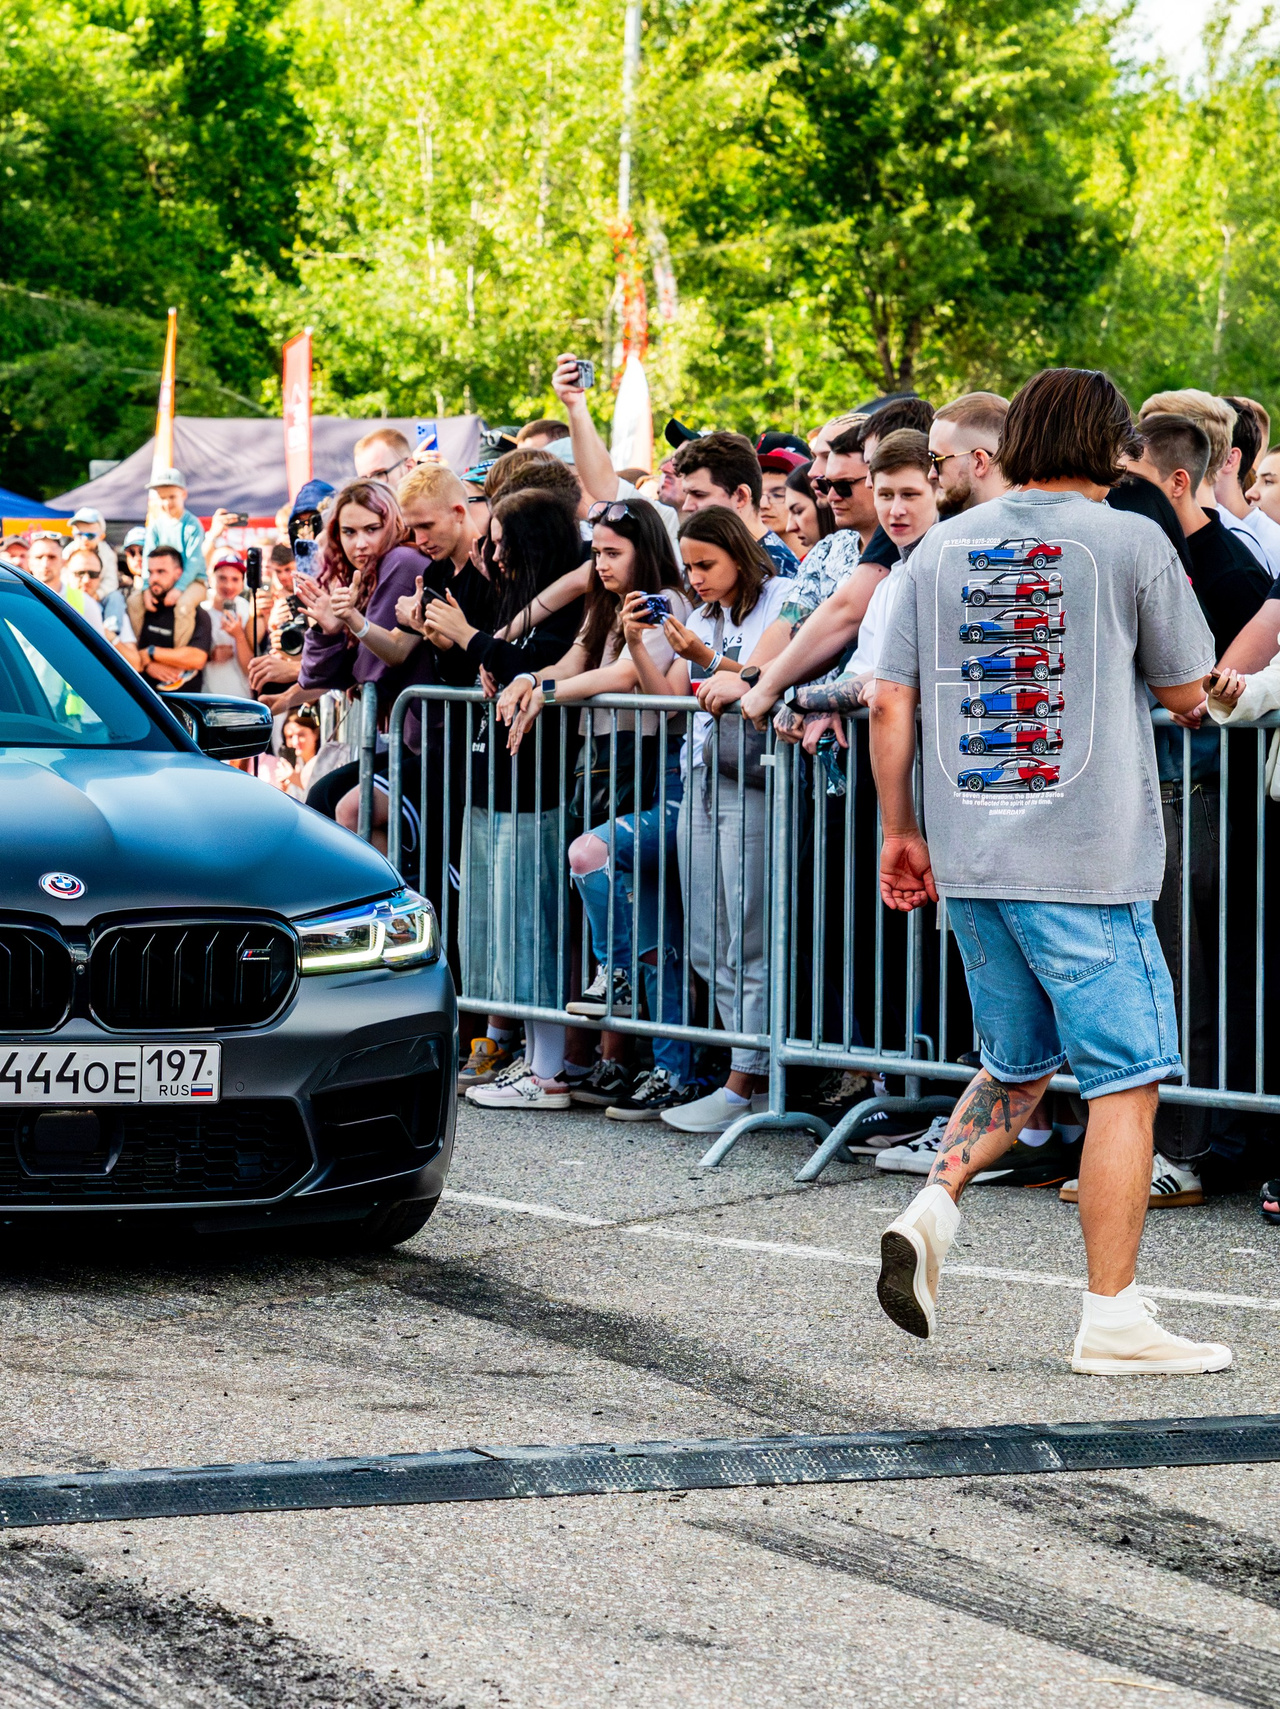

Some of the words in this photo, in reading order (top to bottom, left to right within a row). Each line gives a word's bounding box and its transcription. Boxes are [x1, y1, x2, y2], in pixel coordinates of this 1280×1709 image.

[1009, 799, 1024, 807] spirit
[146, 1049, 208, 1082] 197
[159, 1084, 190, 1096] RUS
